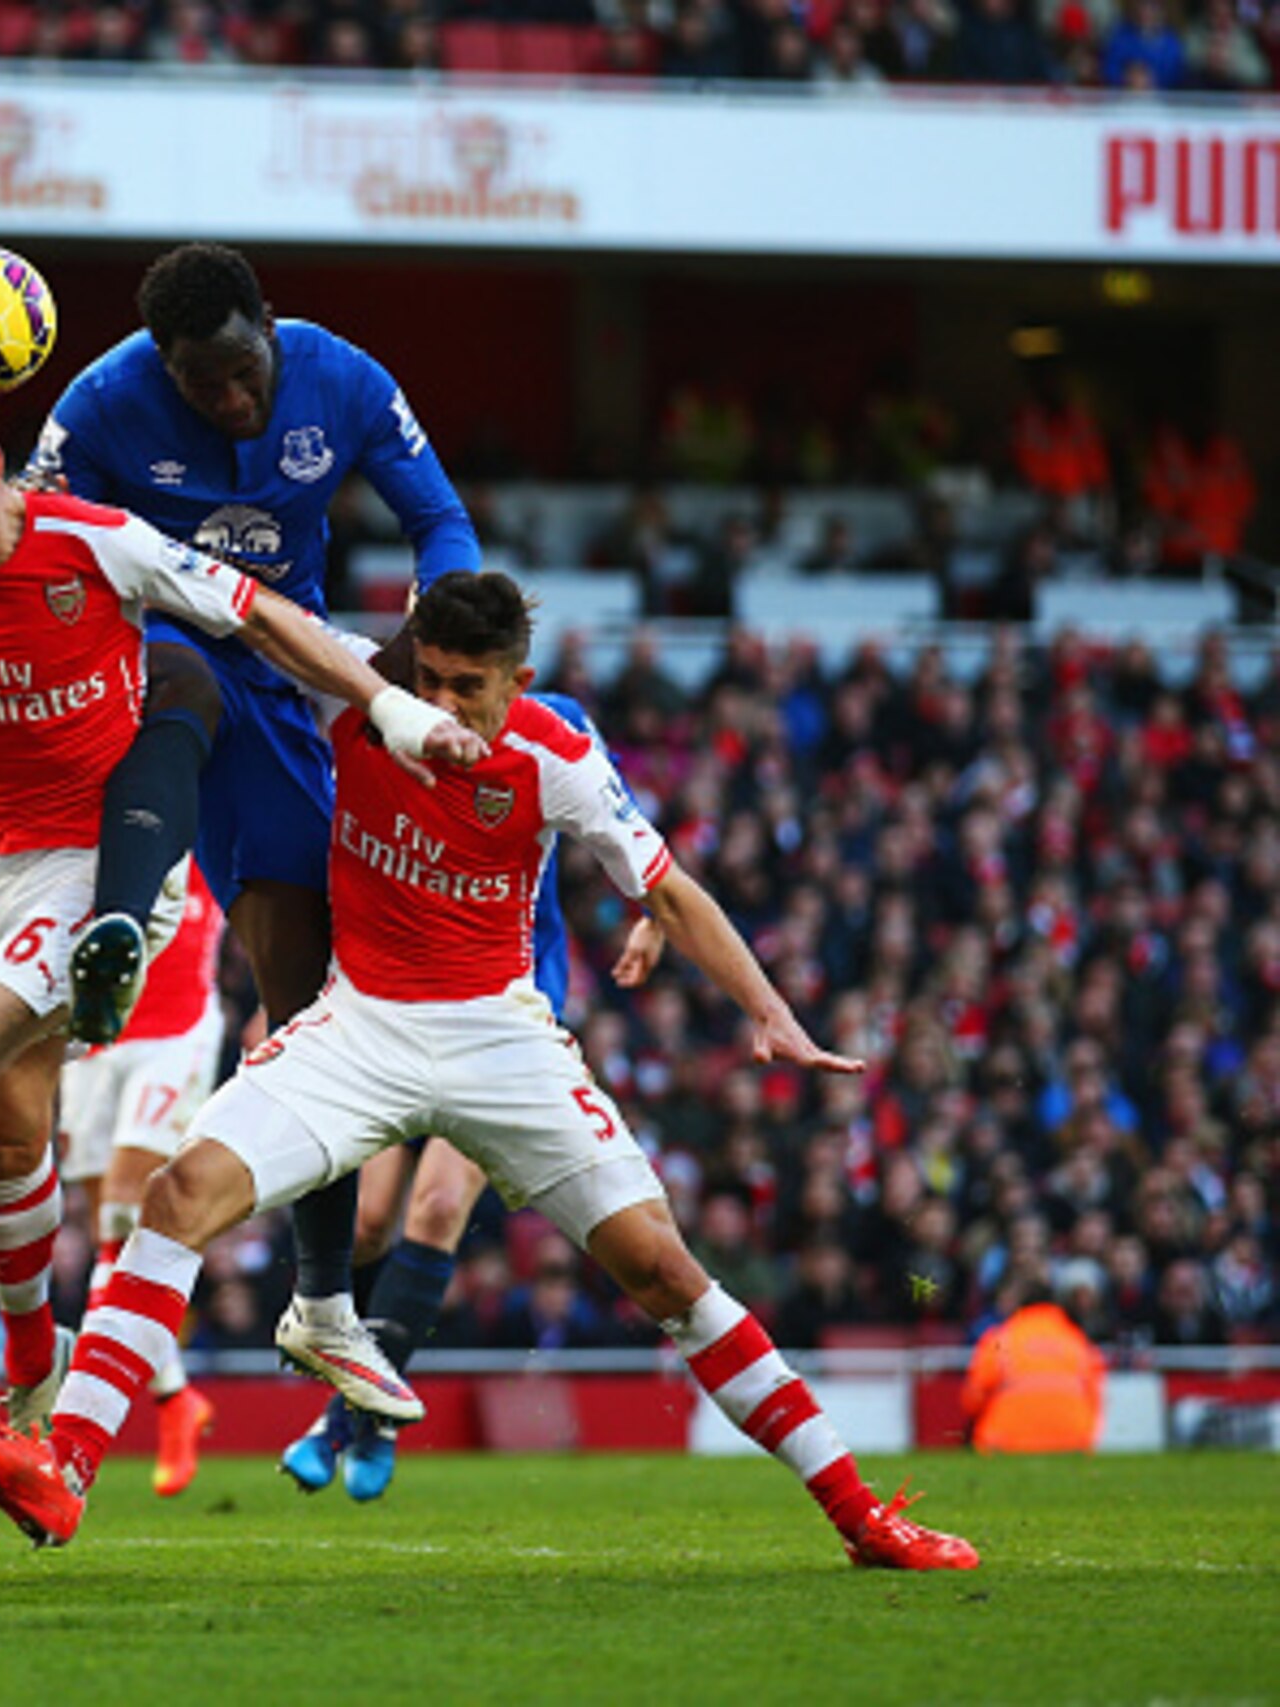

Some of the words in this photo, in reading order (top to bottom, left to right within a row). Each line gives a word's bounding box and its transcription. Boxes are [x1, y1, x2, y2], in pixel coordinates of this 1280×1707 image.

[339, 809, 510, 901] Emirates
[394, 813, 445, 863] Fly
[3, 917, 57, 964] 6
[134, 1082, 179, 1127] 17
[570, 1086, 616, 1142] 5
